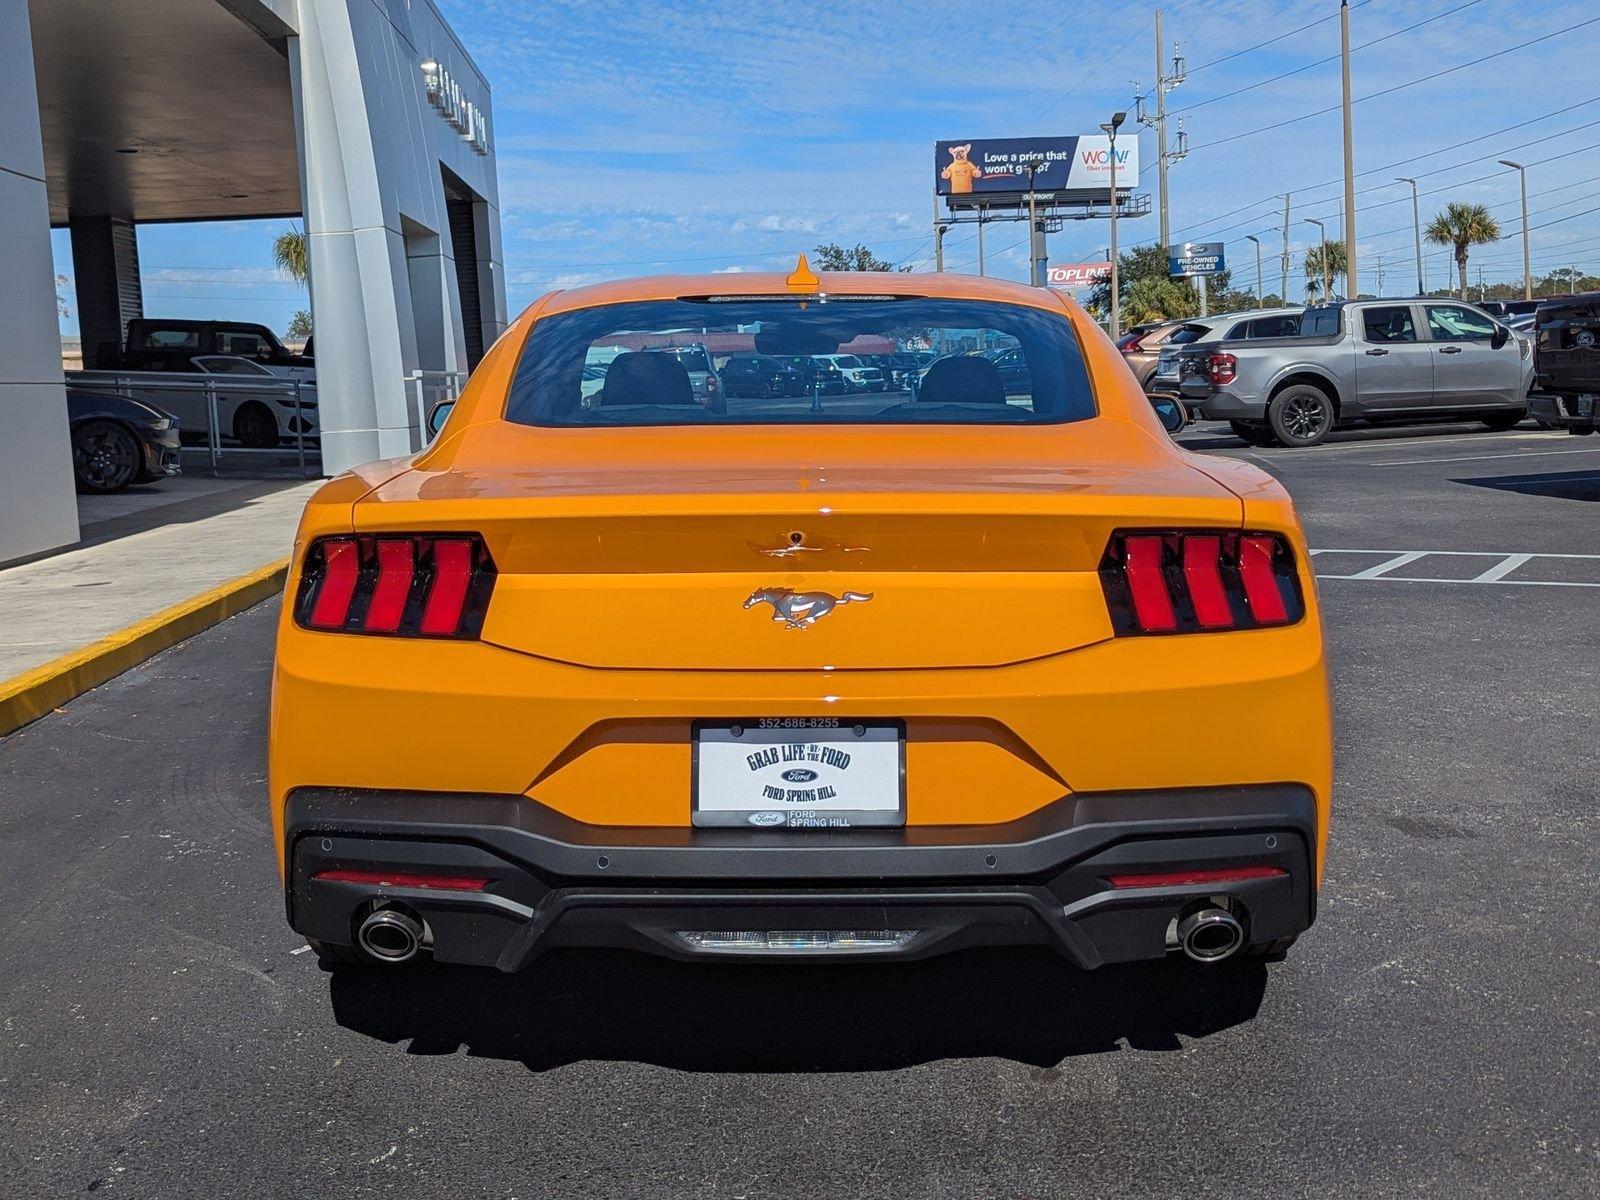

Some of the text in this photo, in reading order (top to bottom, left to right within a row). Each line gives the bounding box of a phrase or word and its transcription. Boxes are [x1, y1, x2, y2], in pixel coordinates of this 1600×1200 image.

[984, 150, 1067, 163] Love a price that
[984, 163, 1015, 174] won't
[1177, 256, 1219, 265] PRE-OWNED
[1181, 263, 1216, 271] VEHICLES
[759, 718, 839, 729] 352-686-8255
[746, 744, 851, 771] GRAB LIFE BY THE FORD
[762, 784, 837, 802] FORD SPRING HILL
[789, 810, 816, 819] FORD
[789, 818, 851, 827] SPRING HILL
